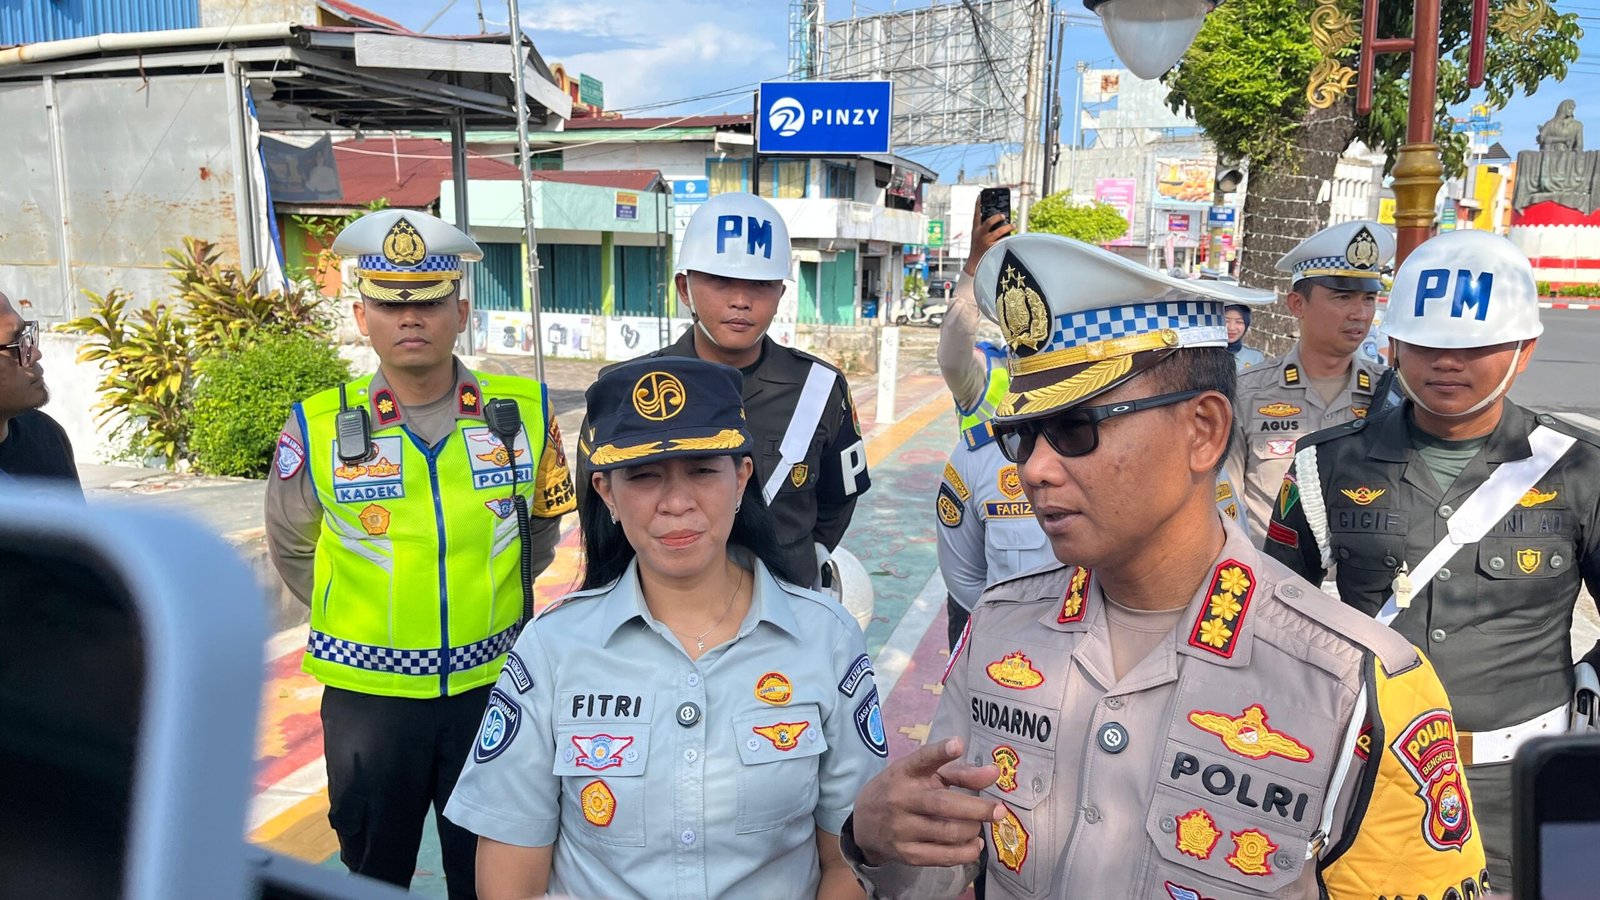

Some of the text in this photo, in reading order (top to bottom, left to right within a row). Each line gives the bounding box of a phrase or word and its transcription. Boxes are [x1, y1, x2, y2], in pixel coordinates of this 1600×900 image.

[811, 108, 879, 126] PINZY
[716, 214, 773, 260] PM
[1414, 268, 1494, 321] PM
[1260, 419, 1299, 432] AGUS
[478, 469, 529, 487] POLRI
[340, 485, 399, 501] KADEK
[995, 503, 1034, 515] FARIZ
[1492, 511, 1526, 533] NI
[571, 694, 642, 718] FITRI
[971, 696, 1052, 743] SUDARNO
[1171, 752, 1309, 823] POLRI
